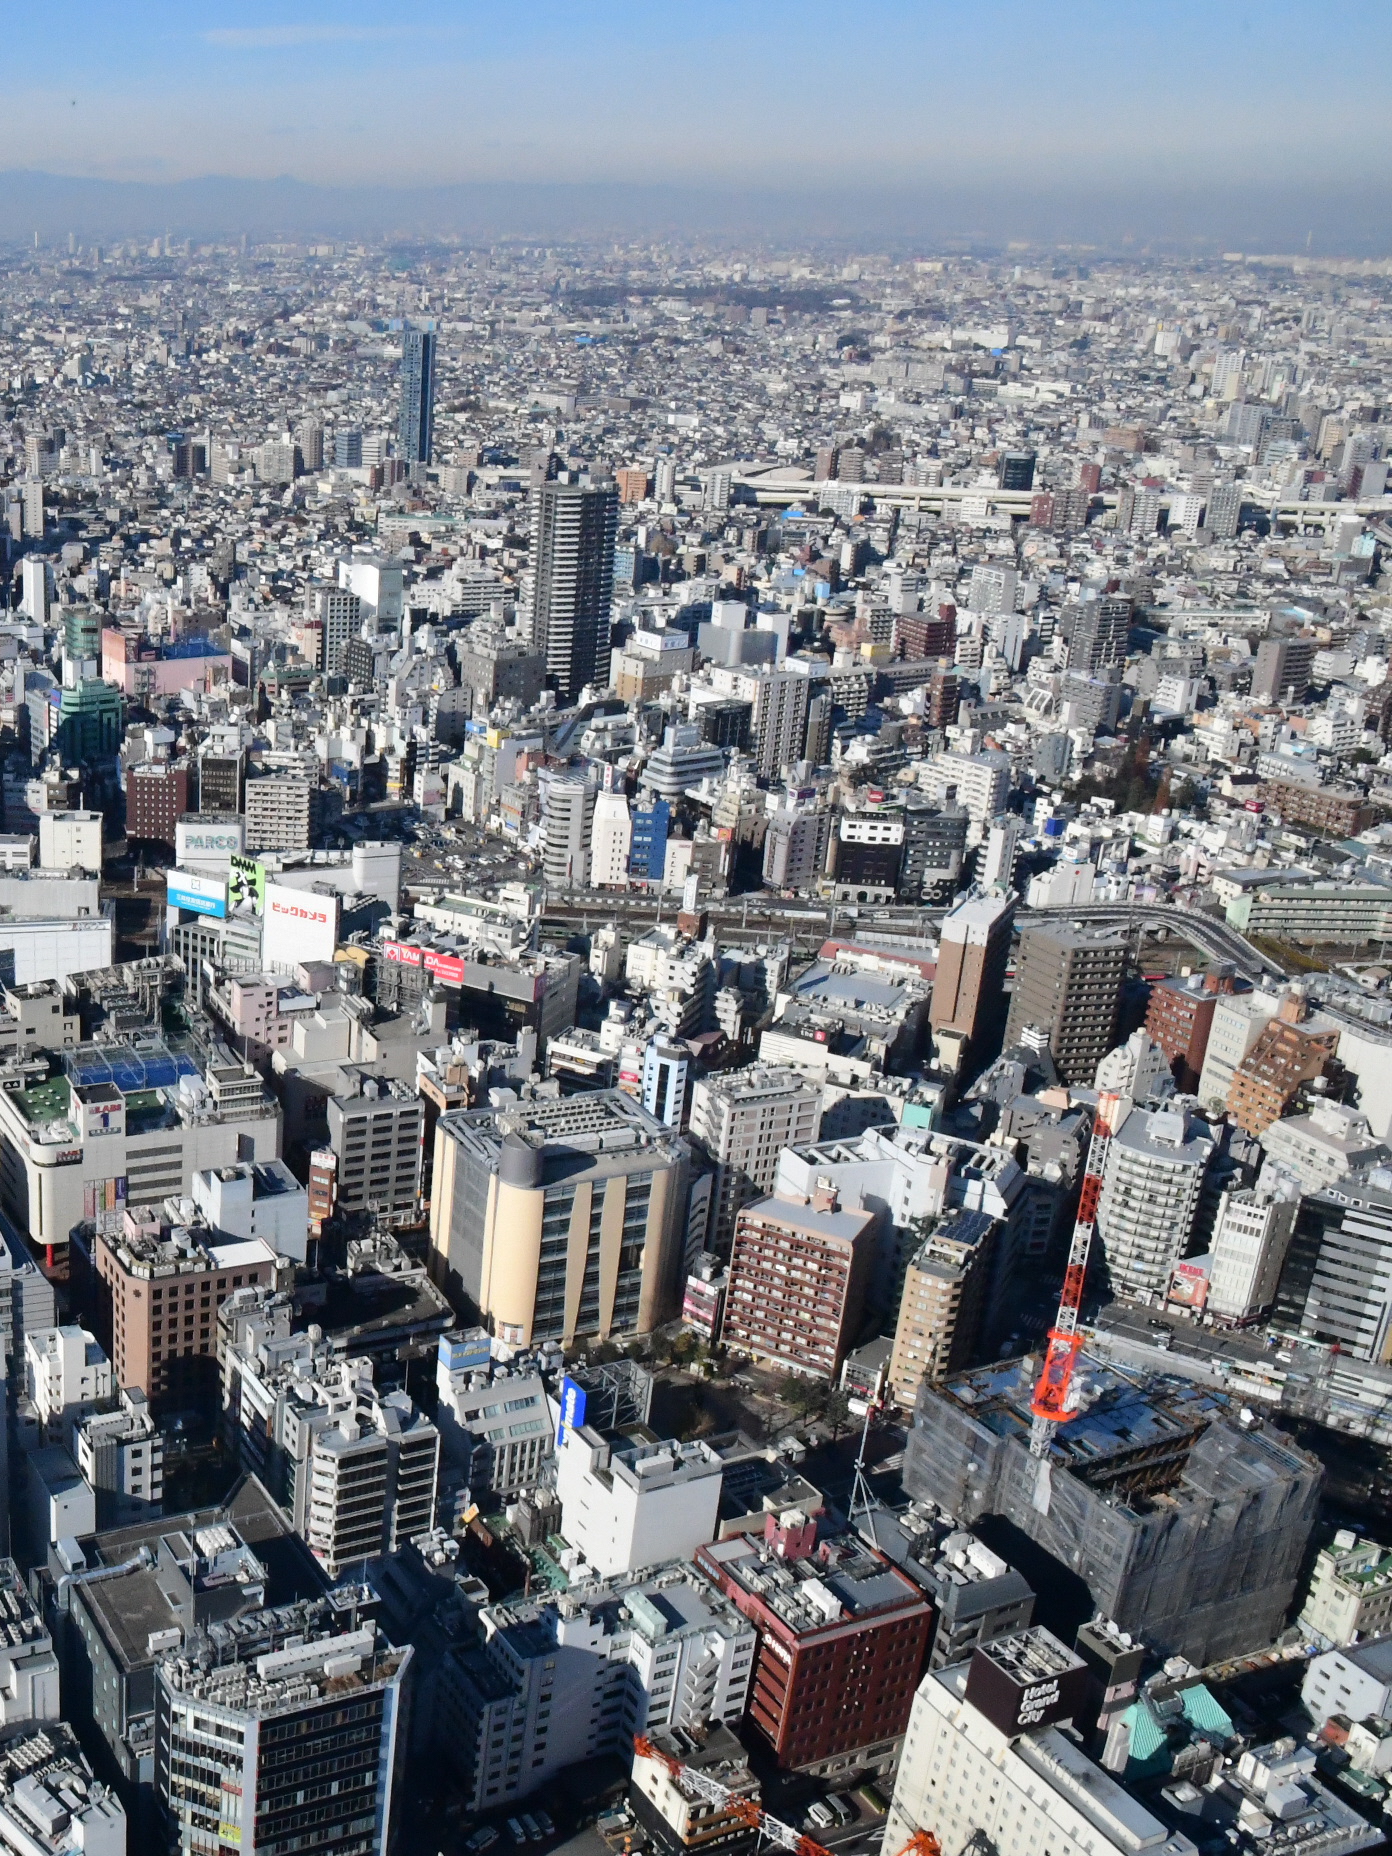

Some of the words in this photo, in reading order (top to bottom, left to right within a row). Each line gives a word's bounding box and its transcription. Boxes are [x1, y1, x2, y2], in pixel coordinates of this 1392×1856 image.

[185, 835, 239, 850] PARCO
[272, 902, 327, 923] ビックカメラ
[800, 1030, 814, 1039] the
[1024, 1680, 1059, 1701] Hotel
[1020, 1690, 1061, 1713] Grand
[1017, 1709, 1045, 1726] City
